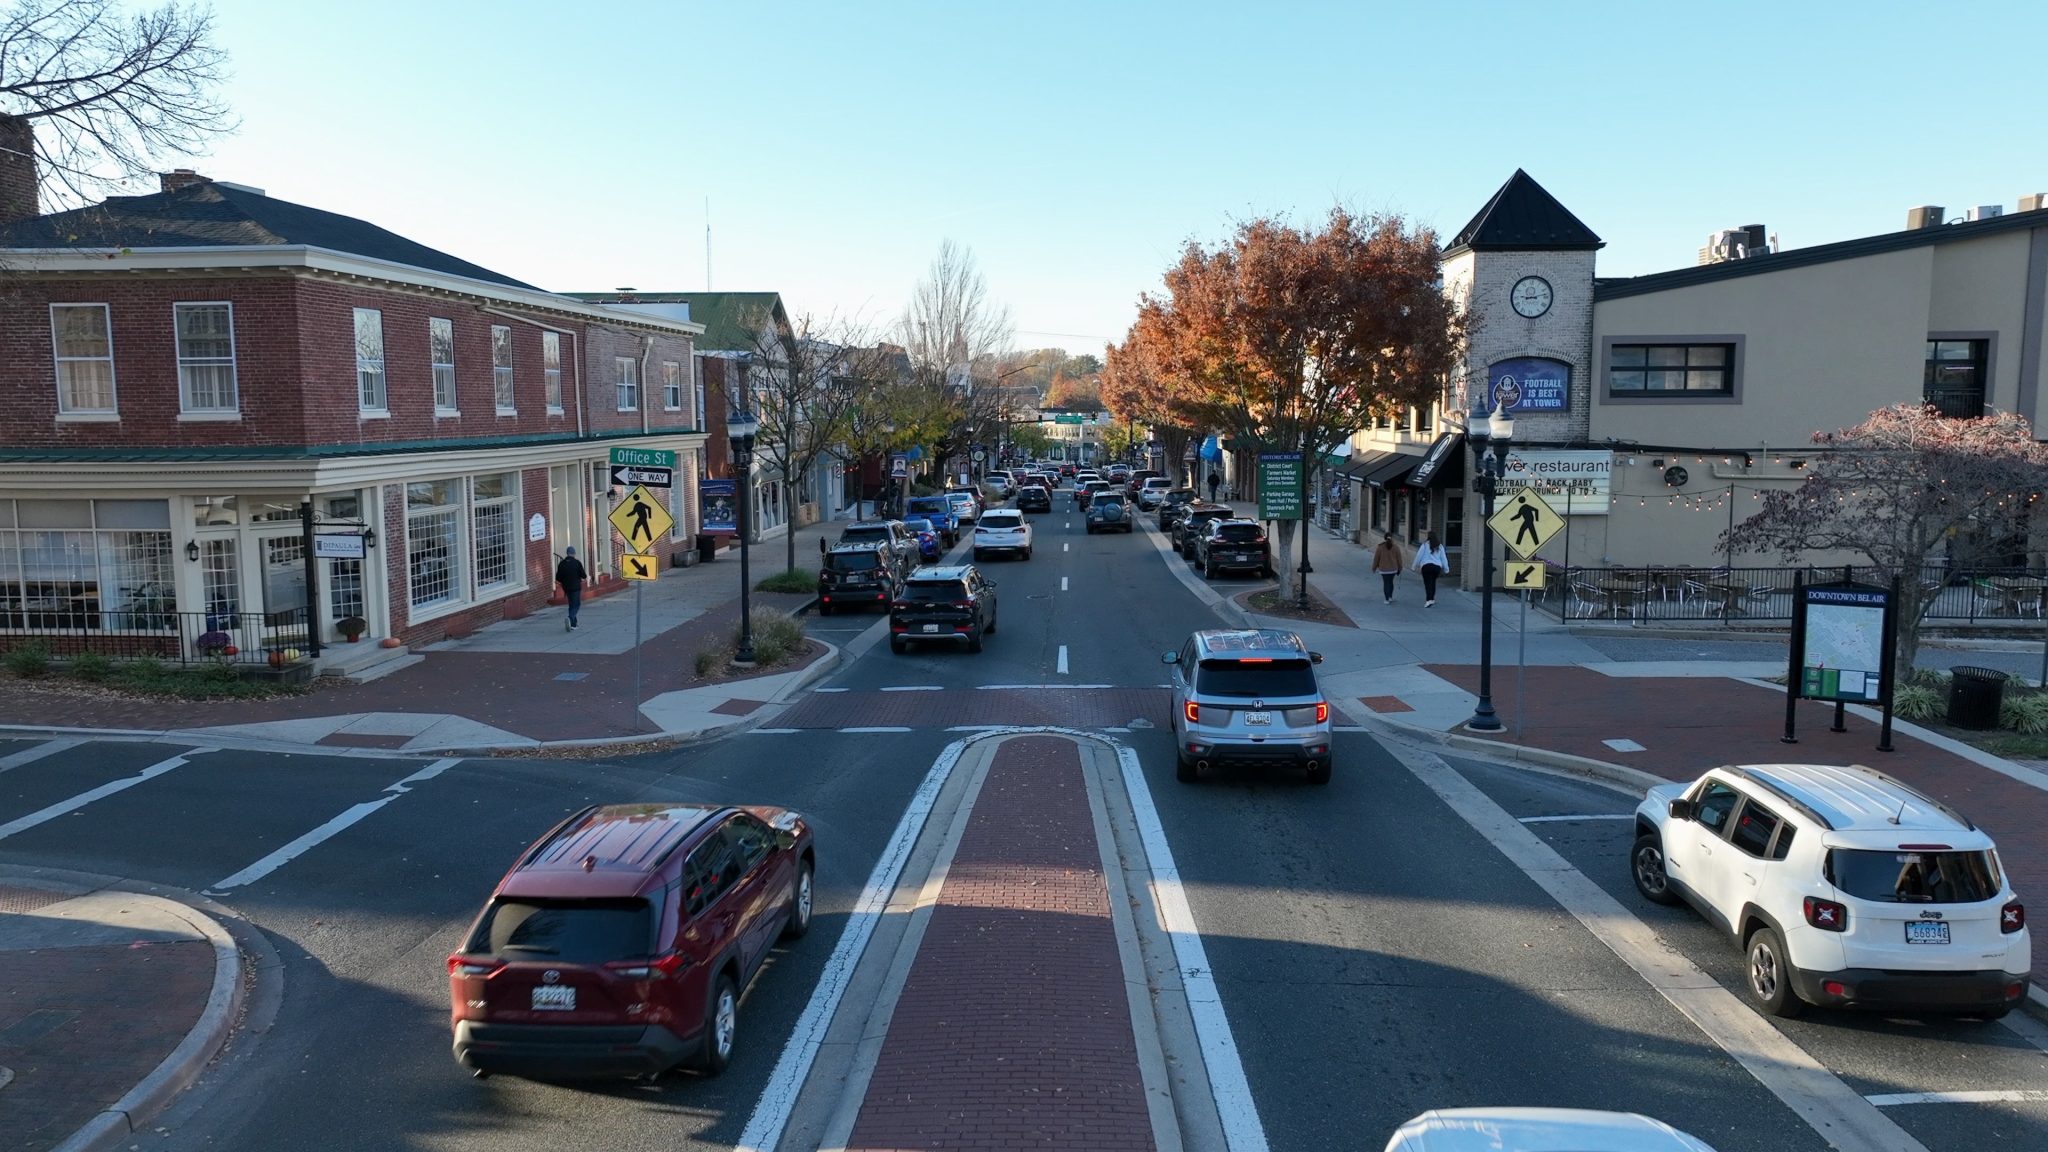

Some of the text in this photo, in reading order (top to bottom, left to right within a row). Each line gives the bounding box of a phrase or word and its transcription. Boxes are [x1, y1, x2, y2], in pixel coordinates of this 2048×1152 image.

[1524, 379, 1562, 388] FOOTBALL
[1528, 389, 1558, 398] IS BEST
[1523, 399, 1561, 408] AT TOWER
[617, 450, 666, 464] Office St
[1534, 460, 1610, 473] restaurant
[628, 472, 665, 482] ONE WAY
[1572, 479, 1593, 487] BABY
[1592, 487, 1597, 495] 2
[1809, 592, 1856, 601] DOWNTOWN
[1857, 594, 1870, 602] BEL
[1920, 910, 1942, 919] Jeep
